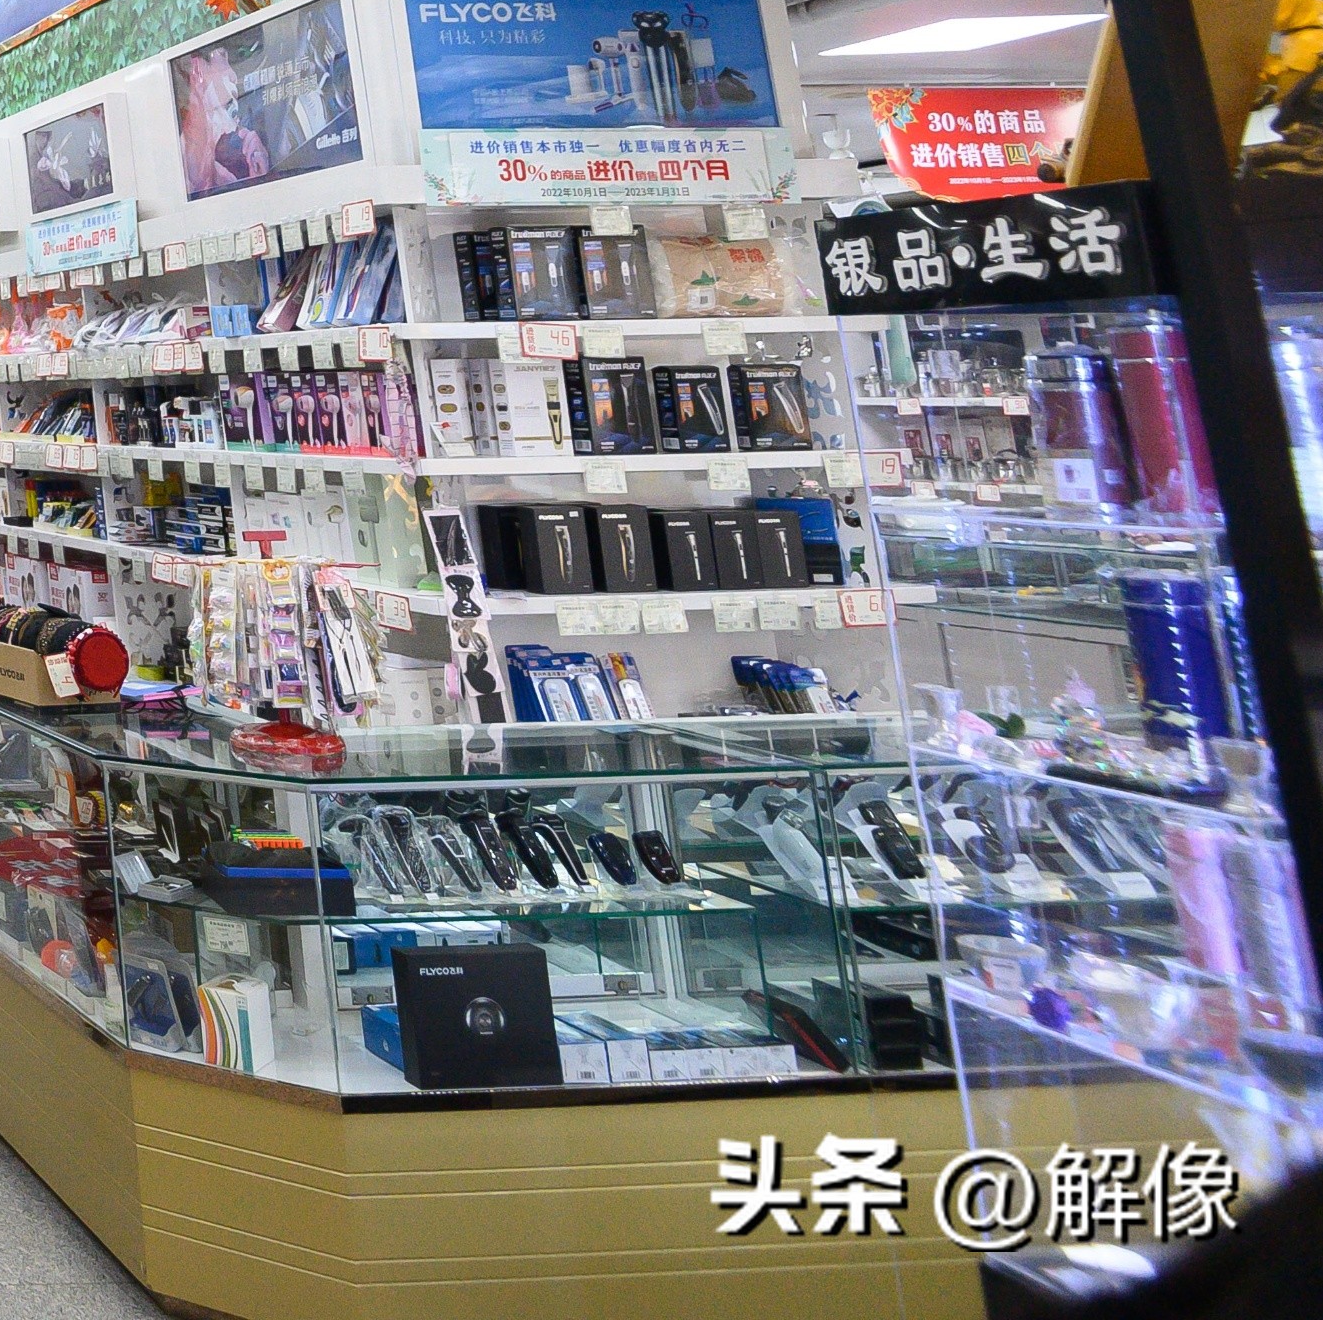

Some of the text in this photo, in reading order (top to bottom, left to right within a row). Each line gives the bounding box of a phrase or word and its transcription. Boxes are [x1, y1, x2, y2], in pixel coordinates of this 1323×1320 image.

[927, 108, 1046, 134] 30%的商品
[469, 139, 747, 155] 进价销售本市独一 优惠幅度省内无二
[497, 158, 731, 183] 30%的商品进价销售四个月
[549, 329, 570, 346] 46
